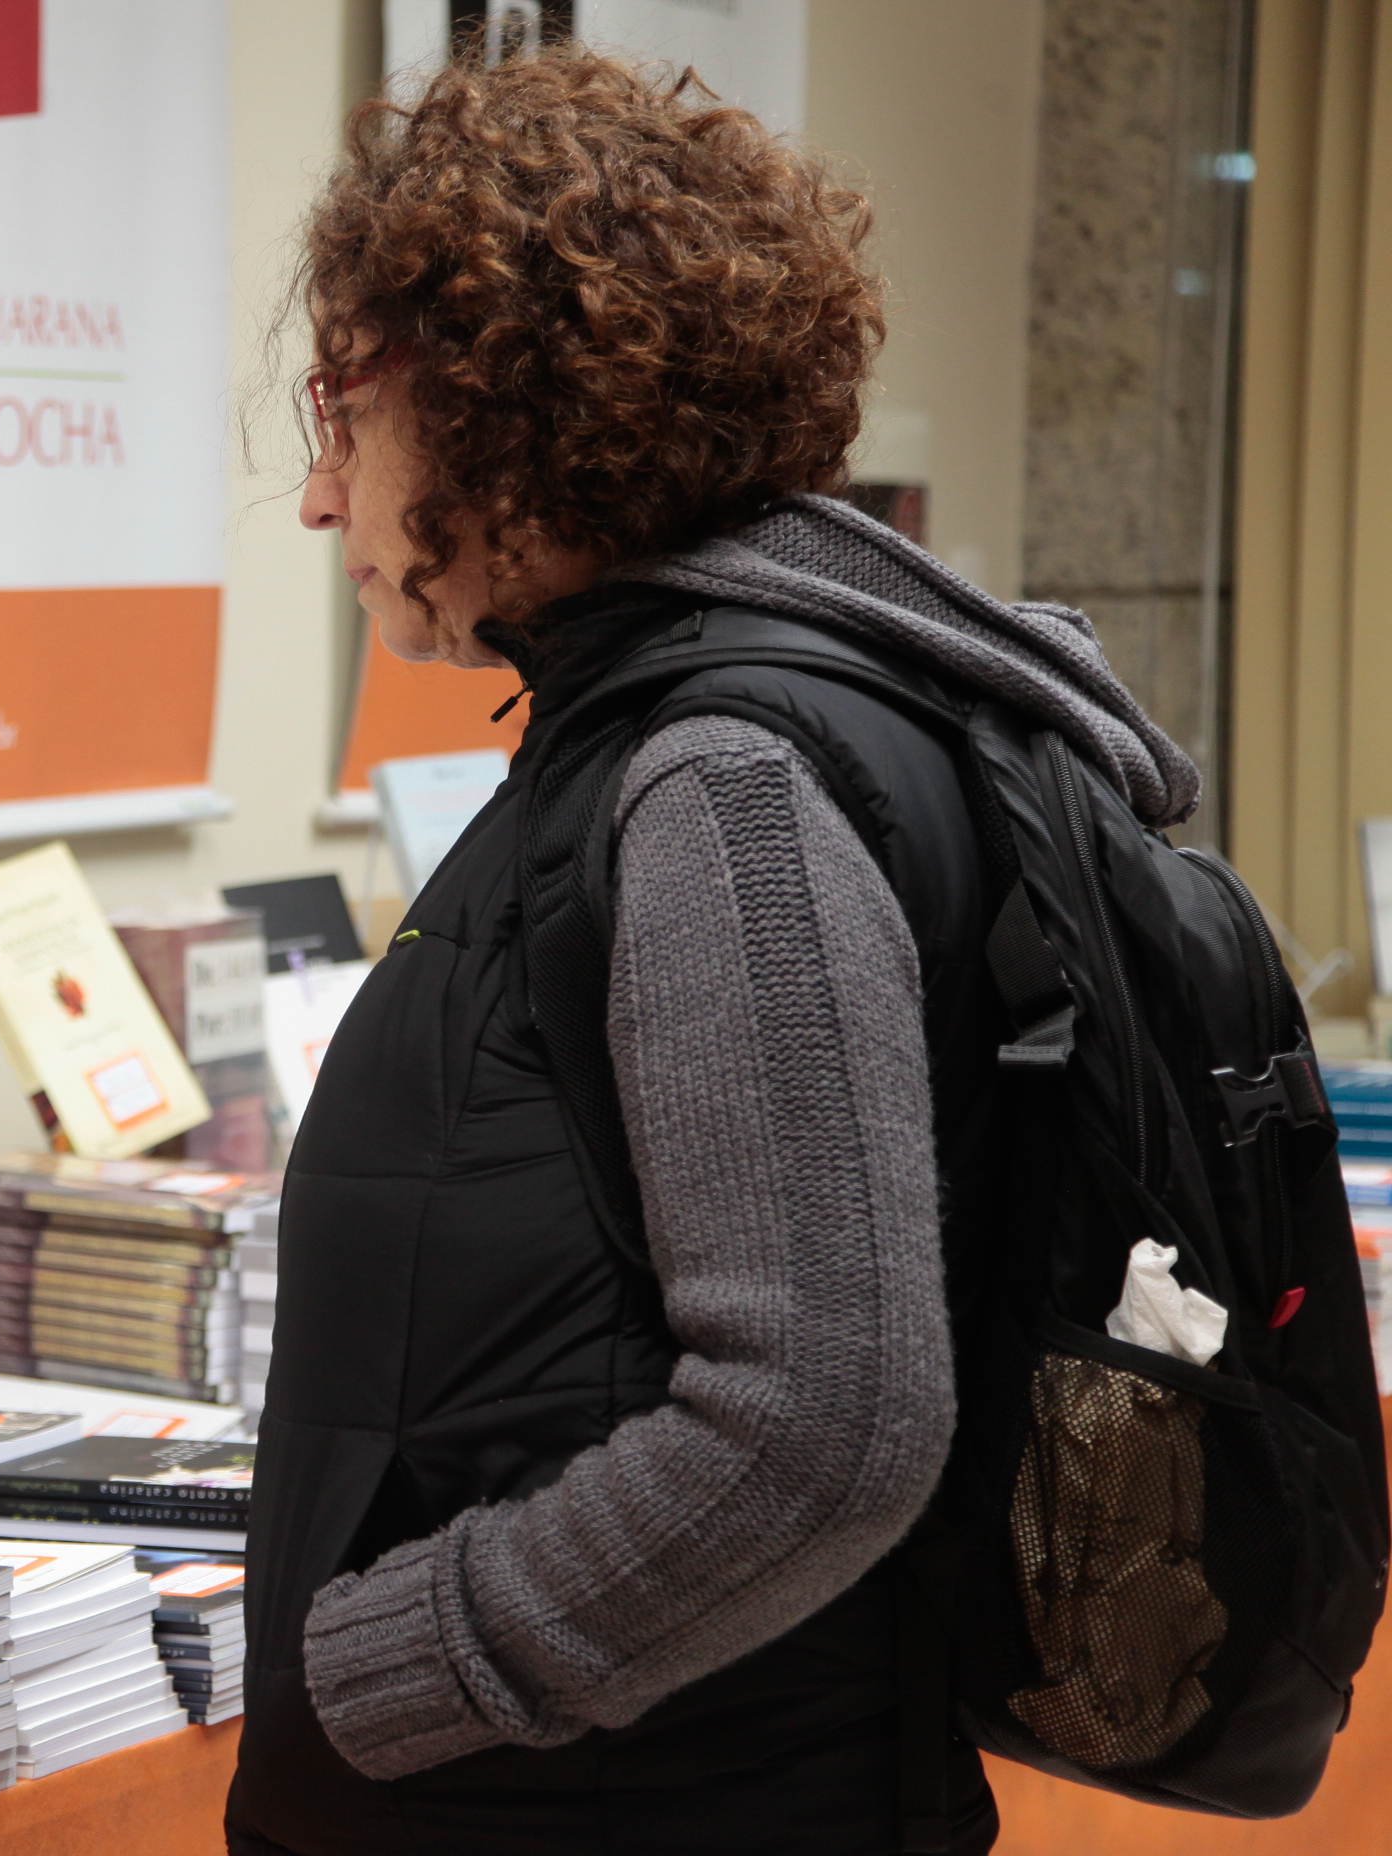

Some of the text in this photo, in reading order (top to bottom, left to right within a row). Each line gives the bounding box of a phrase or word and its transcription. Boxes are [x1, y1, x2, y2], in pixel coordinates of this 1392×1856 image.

[99, 1483, 173, 1498] catarina
[178, 1486, 228, 1501] conto
[188, 1509, 238, 1523] conto
